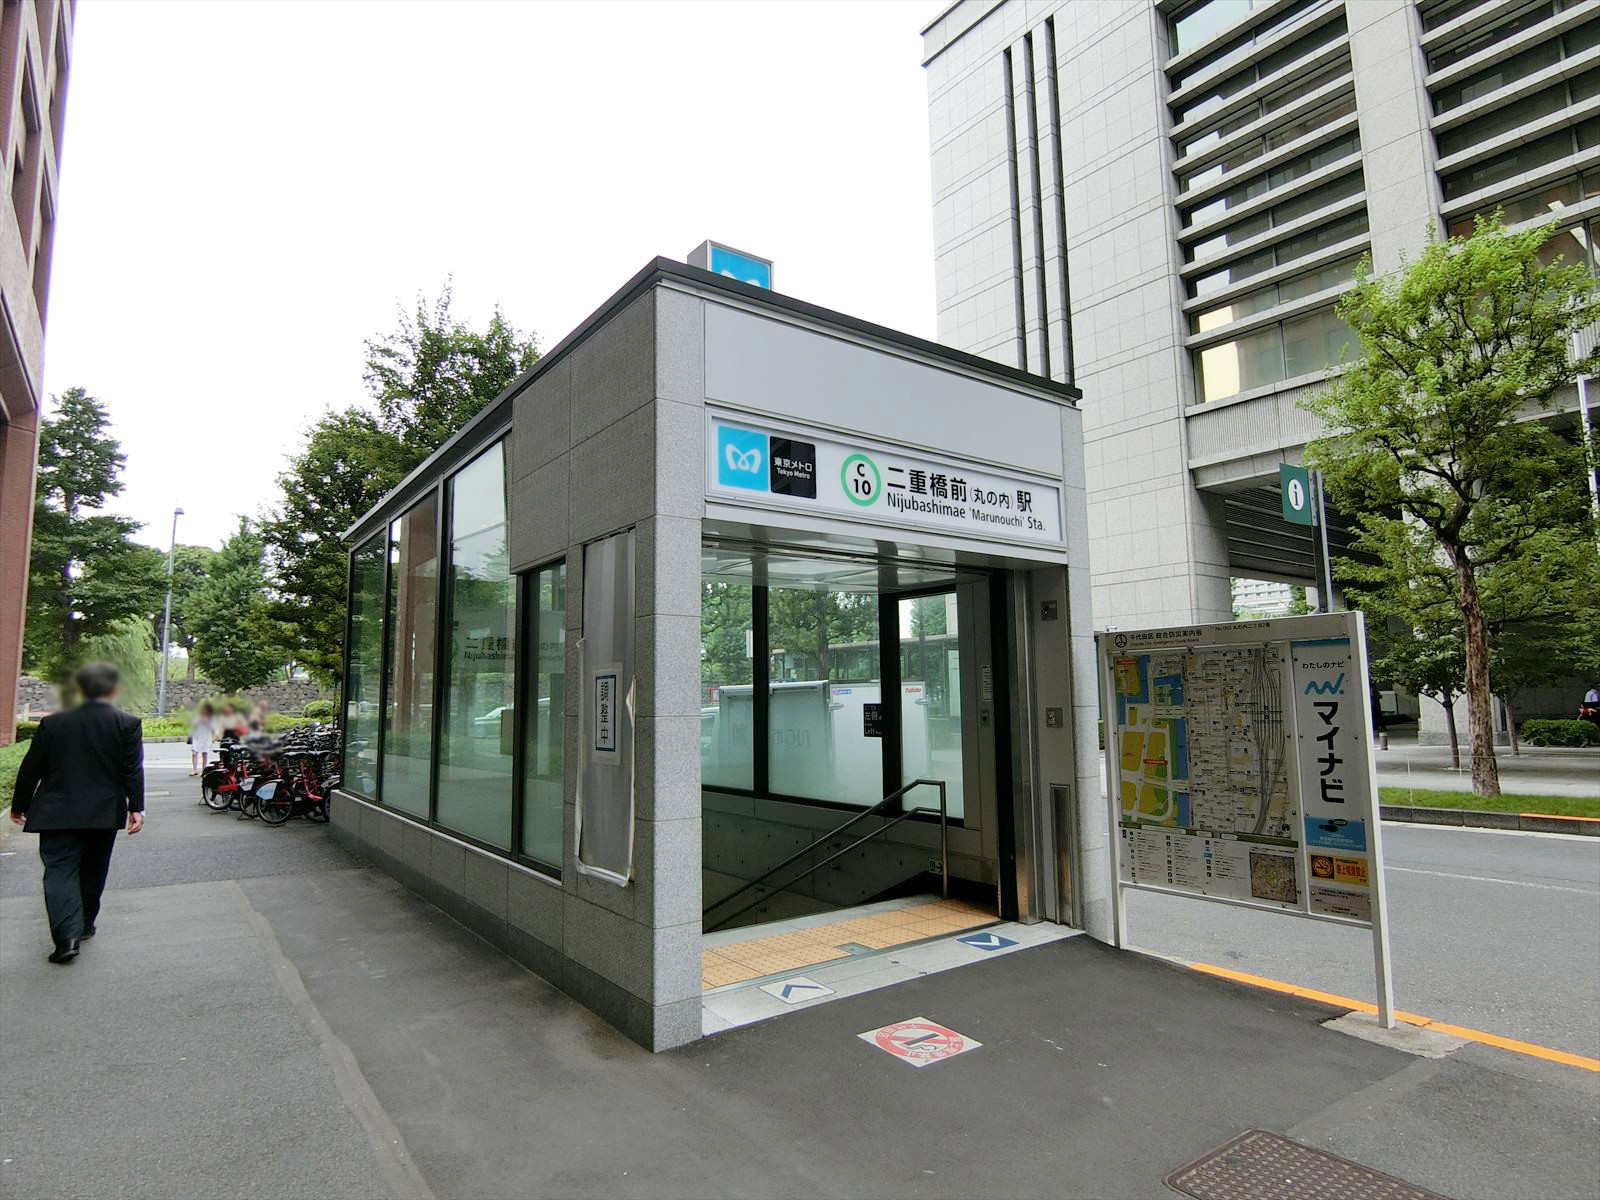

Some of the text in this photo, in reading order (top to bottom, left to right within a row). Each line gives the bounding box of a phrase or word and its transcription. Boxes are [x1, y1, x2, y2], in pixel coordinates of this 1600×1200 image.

[774, 457, 813, 472] 東京メトロ
[857, 463, 865, 477] C
[776, 467, 811, 479] Tokyo Metro
[853, 478, 872, 496] 10
[887, 492, 966, 519] Nijubashimae
[1027, 516, 1046, 532] Sta.
[1302, 661, 1345, 669] わたしのナビ
[1313, 701, 1345, 804] マイナビ
